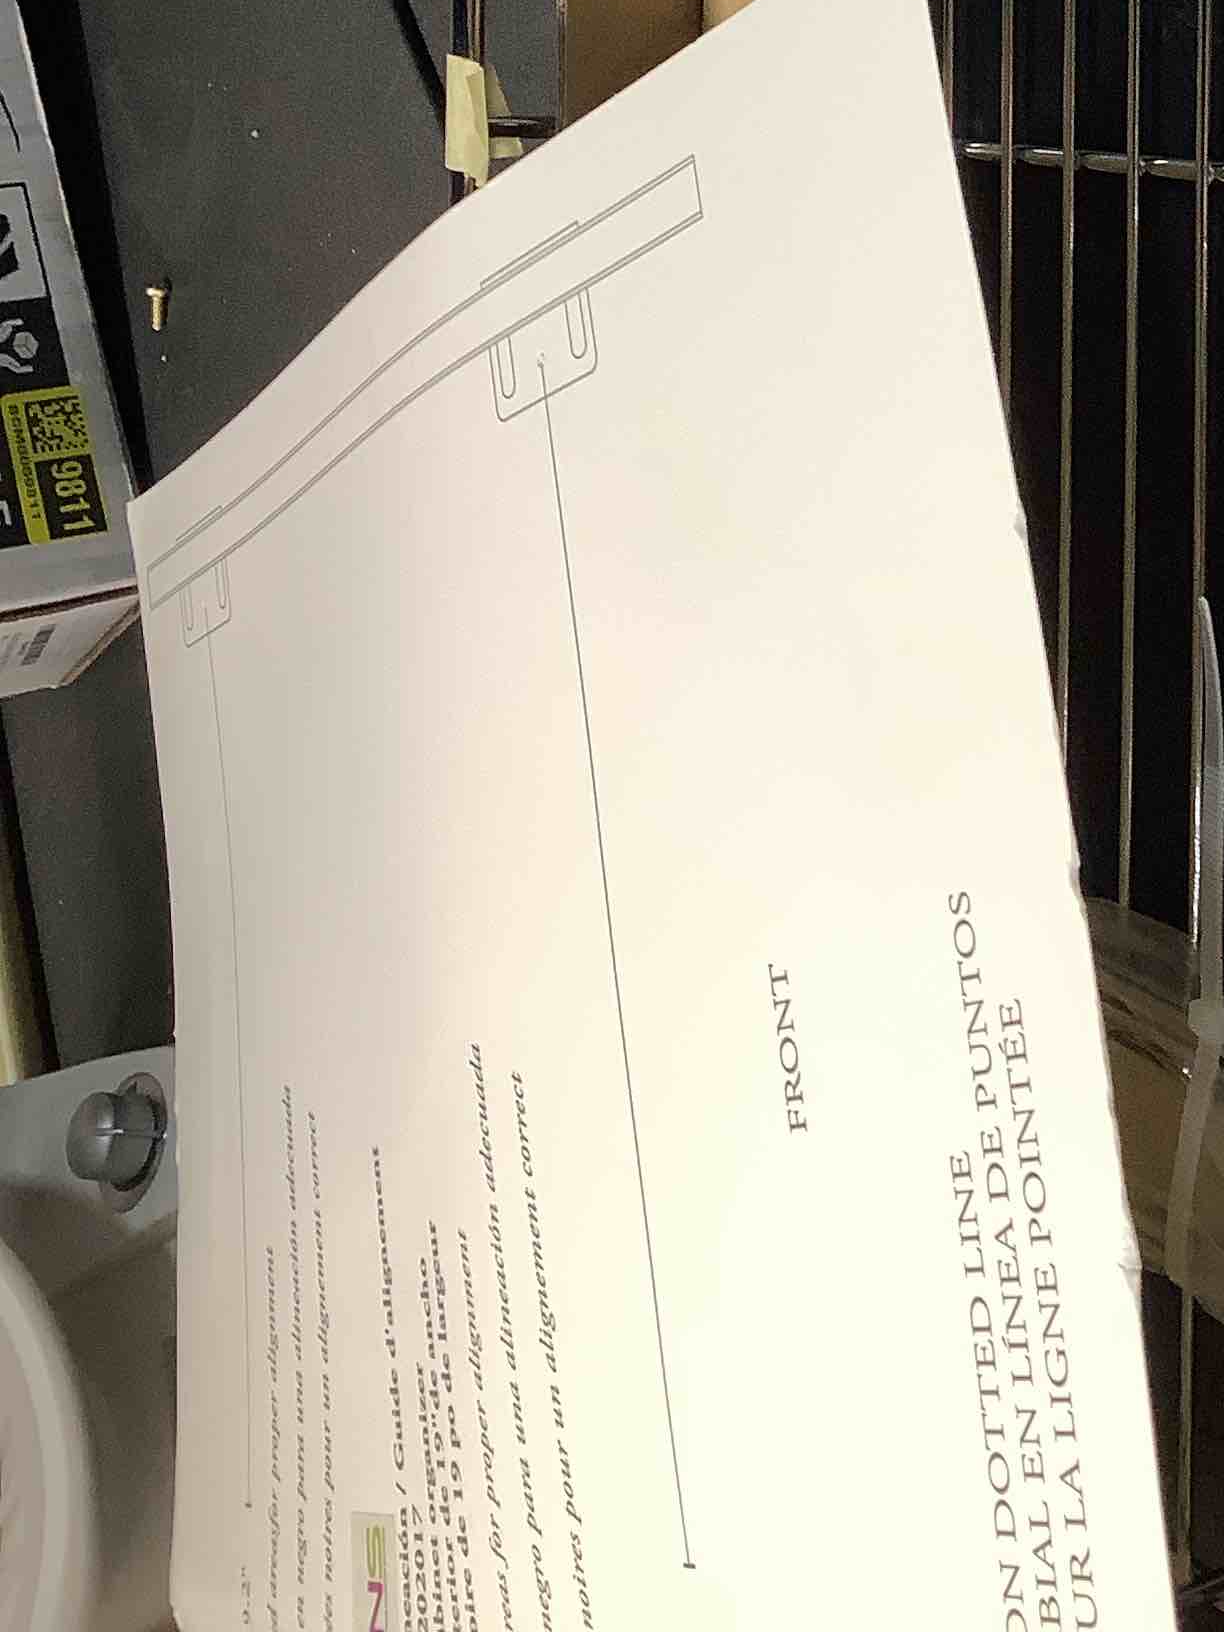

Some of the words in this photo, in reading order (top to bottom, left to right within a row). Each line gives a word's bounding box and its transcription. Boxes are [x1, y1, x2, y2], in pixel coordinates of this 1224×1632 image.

[51, 460, 97, 530] 9811
[767, 963, 808, 1135] FRONT
[947, 890, 998, 1113] PUNTOS
[281, 1083, 297, 1211] adecuada
[307, 1110, 321, 1200] correct
[468, 1042, 496, 1193] adecuada
[509, 1070, 534, 1177] correct
[979, 1125, 1011, 1203] DE
[998, 998, 1053, 1248] POINTÉE
[371, 1146, 396, 1358] d'alignement
[948, 1150, 987, 1279] LINE
[266, 1244, 279, 1383] alignment
[314, 1208, 329, 1364] alignement
[419, 1257, 436, 1359] ancho
[428, 1219, 448, 1341] largeur
[457, 1228, 483, 1391] alignment
[487, 1203, 518, 1371] alineación
[523, 1186, 557, 1373] alignement
[993, 1217, 1034, 1386] LÍNEA
[296, 1369, 304, 1425] una
[321, 1373, 330, 1410] un
[440, 1352, 453, 1392] de
[1033, 1261, 1077, 1442] LIGNE
[323, 1419, 335, 1491] pour
[389, 1367, 405, 1471] Guide
[416, 1360, 437, 1524] organizer
[446, 1405, 462, 1450] po
[477, 1398, 502, 1508] proper
[509, 1381, 527, 1445] una
[550, 1384, 565, 1428] un
[969, 1295, 1018, 1543] DOTTED
[1014, 1403, 1046, 1484] EN
[296, 1433, 307, 1502] para
[439, 1485, 451, 1526] de
[450, 1460, 463, 1501] 19
[519, 1456, 542, 1535] para
[557, 1438, 582, 1525] pour
[1059, 1456, 1087, 1531] LA
[297, 1506, 307, 1585] negro
[322, 1496, 333, 1583] noires
[457, 1515, 470, 1557] de
[488, 1512, 509, 1569] for
[569, 1529, 594, 1630] noires
[1027, 1500, 1062, 1632] BIAL
[531, 1543, 552, 1632] negro
